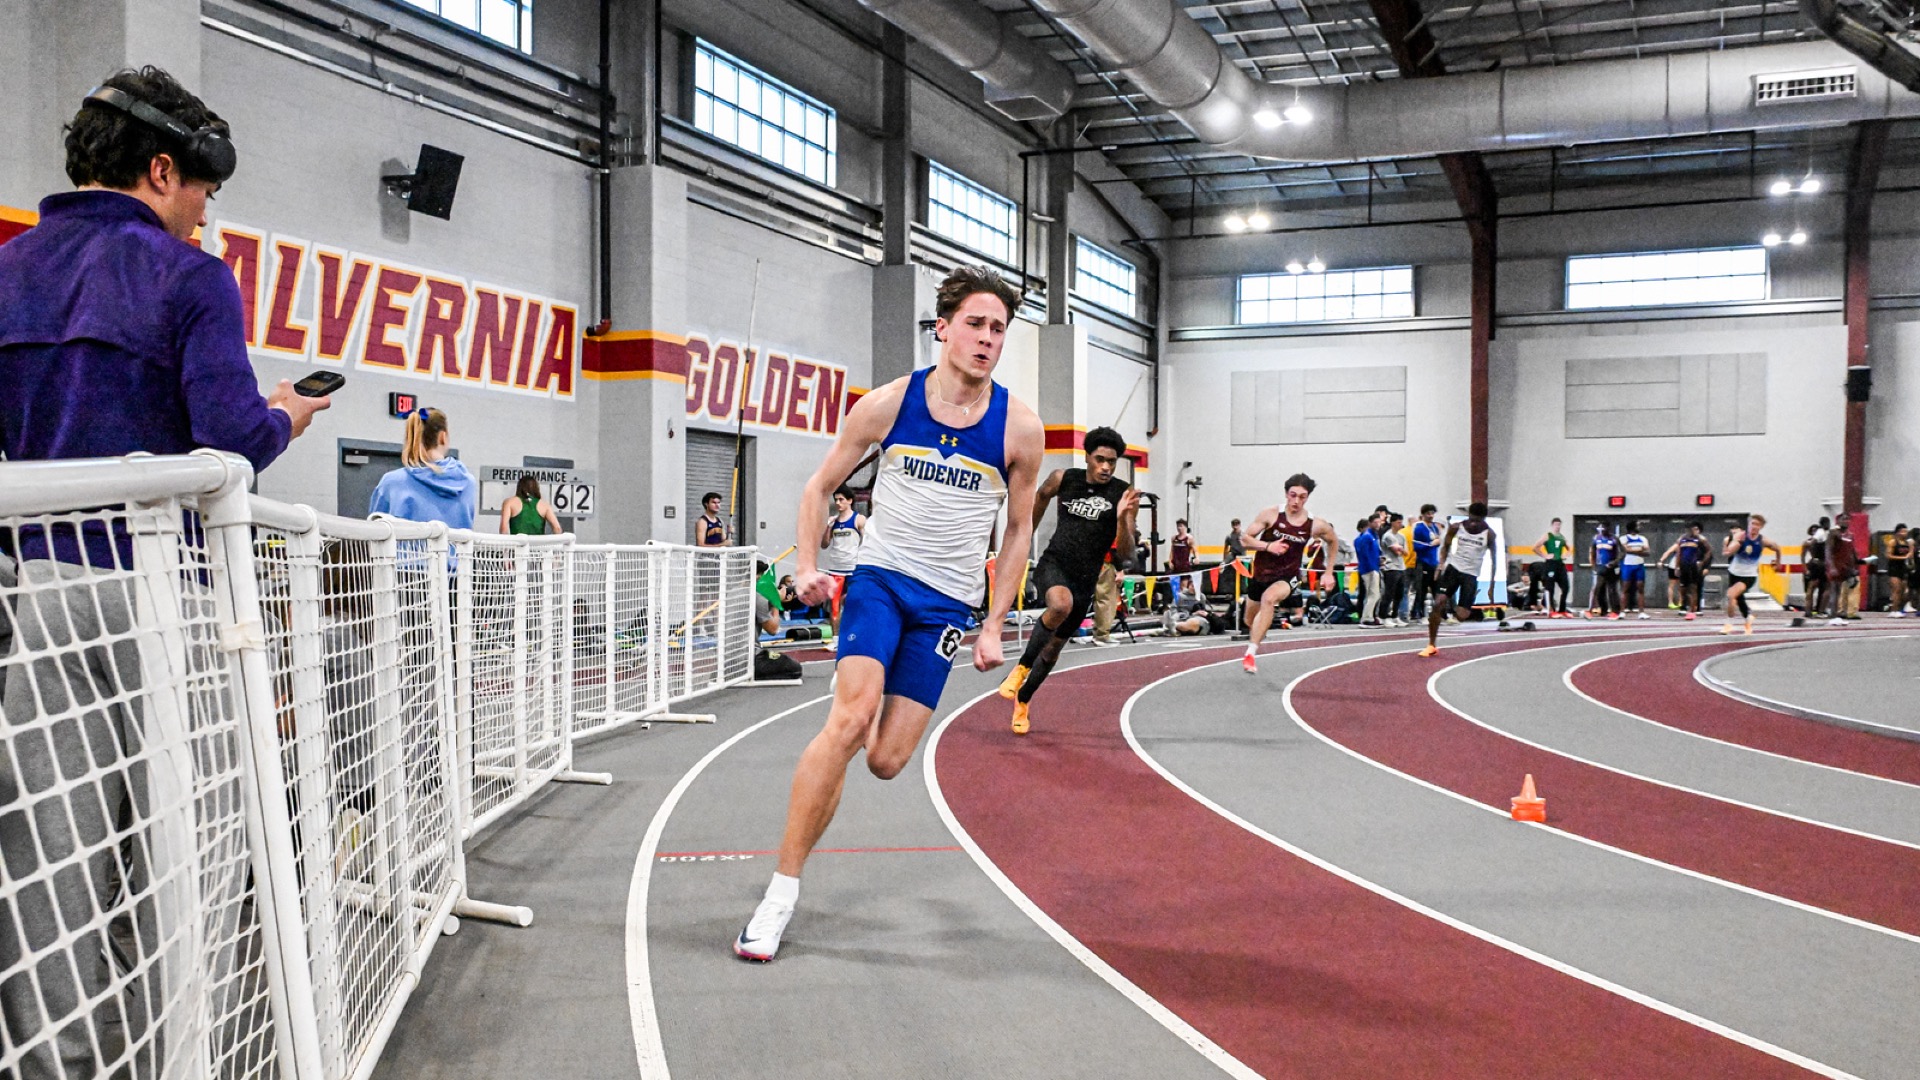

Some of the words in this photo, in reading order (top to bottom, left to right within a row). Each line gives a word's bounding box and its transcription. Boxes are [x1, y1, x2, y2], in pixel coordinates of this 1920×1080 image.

[216, 224, 578, 398] ALVERNIA
[685, 337, 847, 437] GOLDEN
[492, 468, 567, 483] PERFORMANCE
[903, 455, 983, 492] WIDENER
[1070, 501, 1099, 519] HFU
[941, 628, 962, 657] 6
